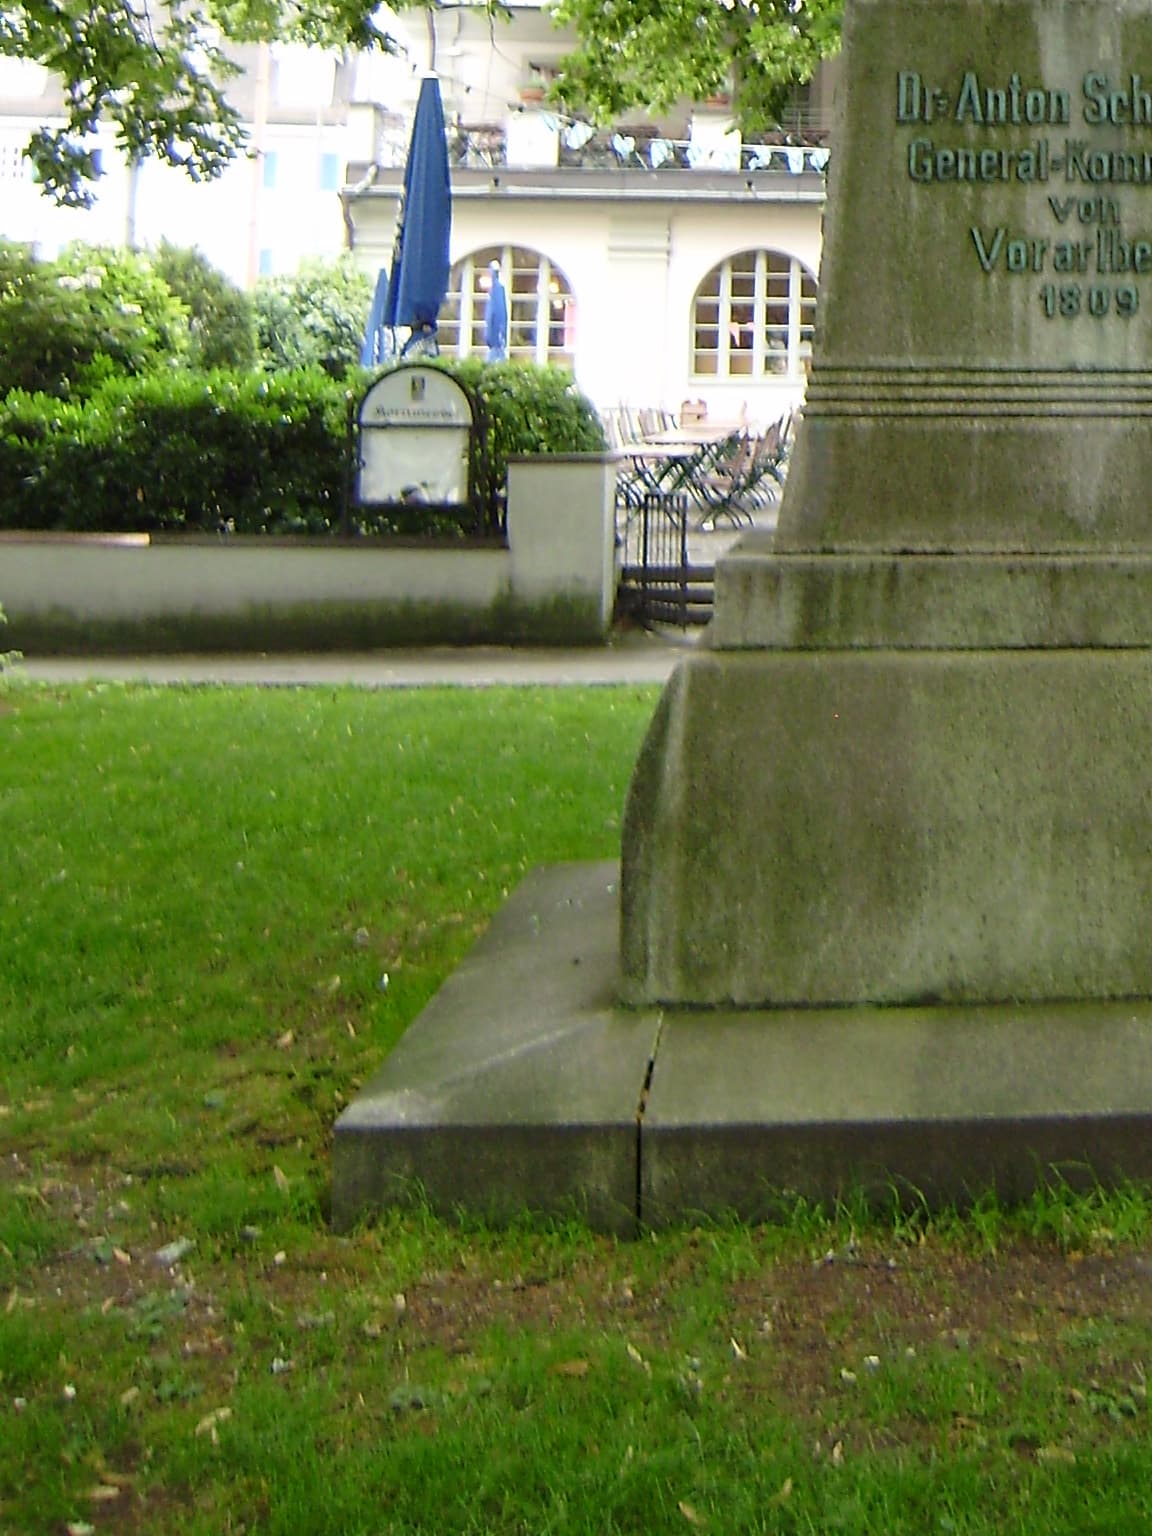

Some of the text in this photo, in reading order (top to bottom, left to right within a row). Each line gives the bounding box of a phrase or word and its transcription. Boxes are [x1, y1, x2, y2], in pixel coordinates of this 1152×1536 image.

[955, 71, 1070, 125] Anton
[1048, 195, 1121, 224] von
[1040, 283, 1139, 318] 1809
